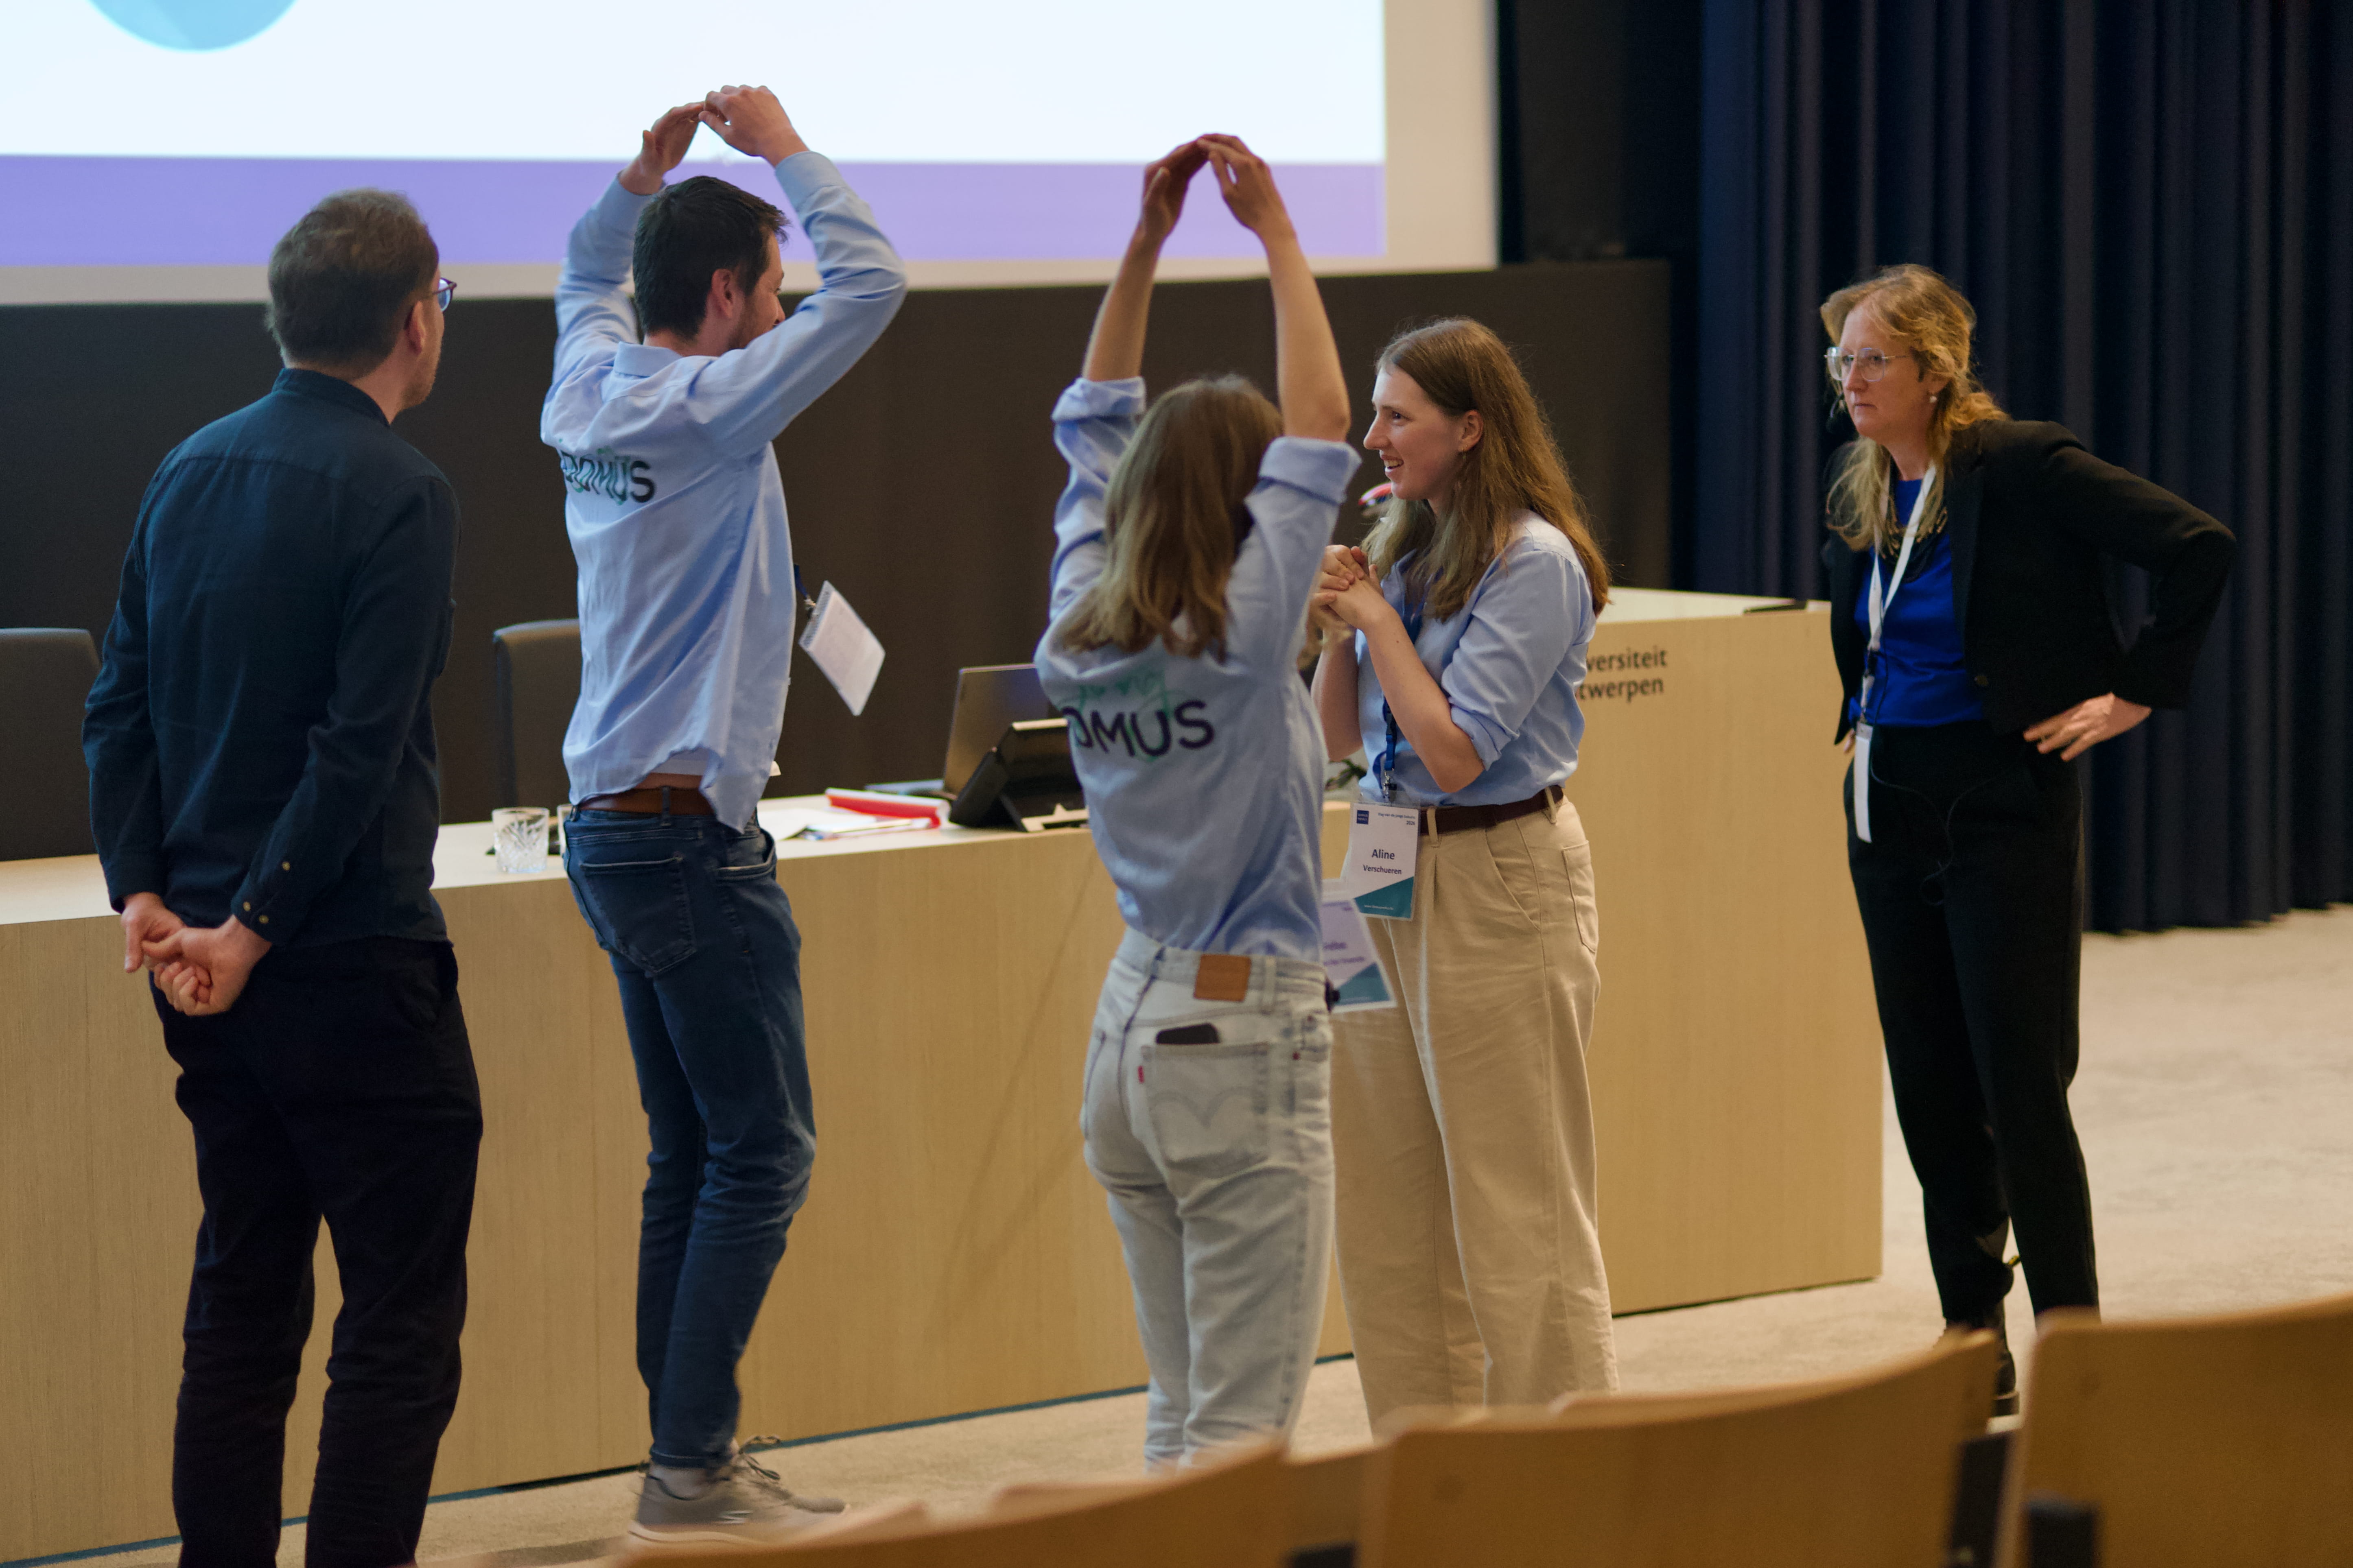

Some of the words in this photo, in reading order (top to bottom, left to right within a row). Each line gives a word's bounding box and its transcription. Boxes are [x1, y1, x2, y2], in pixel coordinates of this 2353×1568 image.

[1587, 646, 1667, 671] versiteit
[1578, 679, 1663, 703] twerpen
[1061, 699, 1215, 758] OMUS
[1371, 849, 1395, 860] Aline
[1362, 864, 1402, 875] Verschueren
